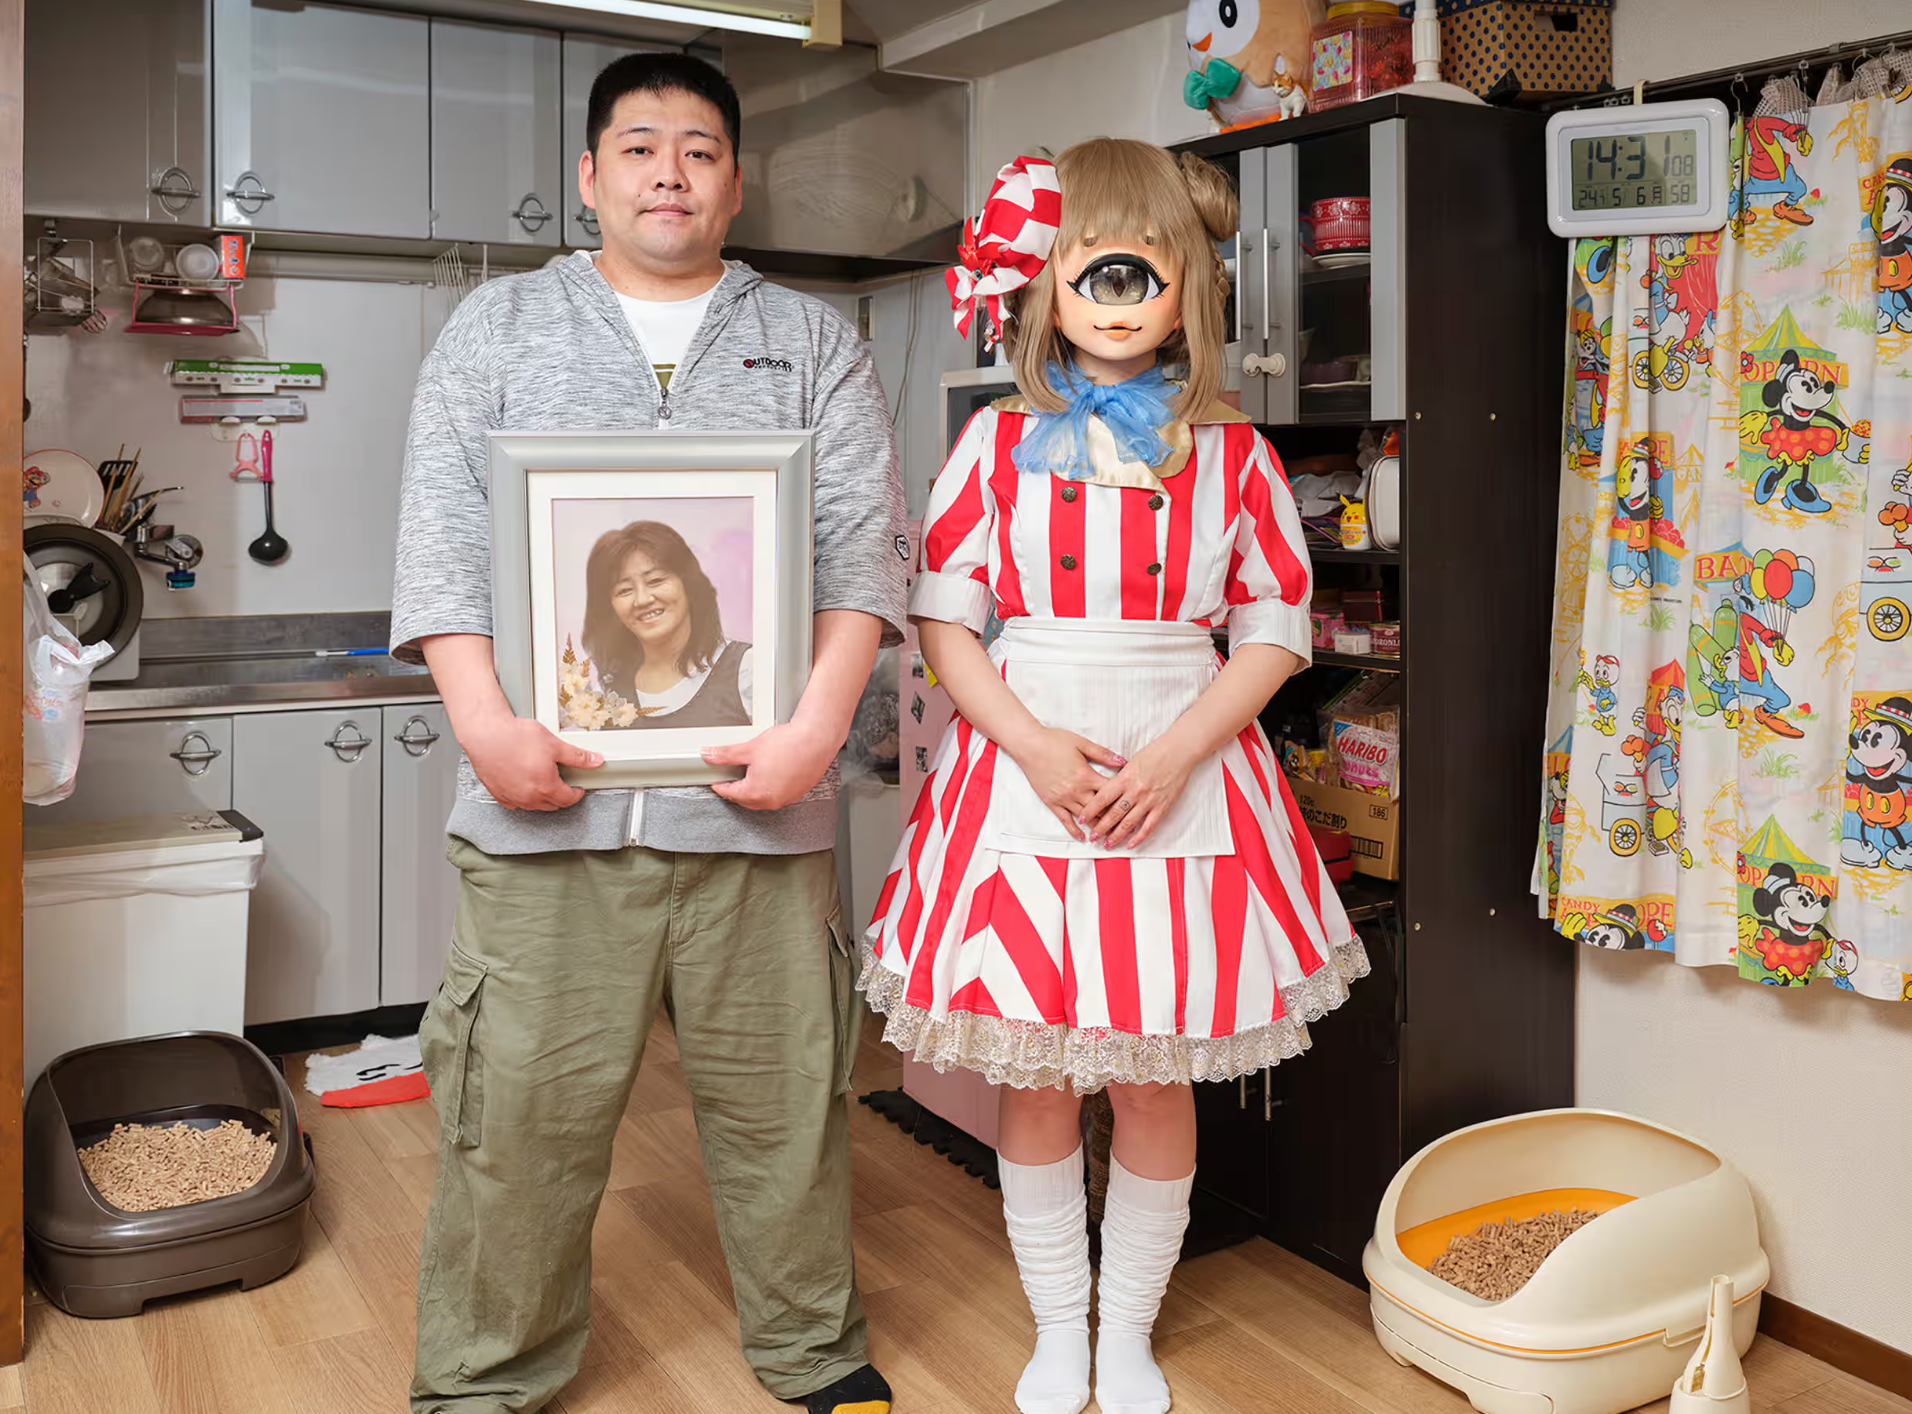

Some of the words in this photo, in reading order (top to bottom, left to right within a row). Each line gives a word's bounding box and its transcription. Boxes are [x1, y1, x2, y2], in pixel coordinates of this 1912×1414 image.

[1587, 135, 1671, 180] 14:31
[1671, 155, 1694, 176] 08
[1579, 190, 1598, 208] 24
[1612, 187, 1622, 206] 5
[1636, 186, 1646, 205] 6
[1670, 184, 1690, 204] 58
[743, 357, 792, 372] OUTDOOR
[1337, 736, 1388, 764] HARIBO
[1561, 896, 1601, 914] CANDY
